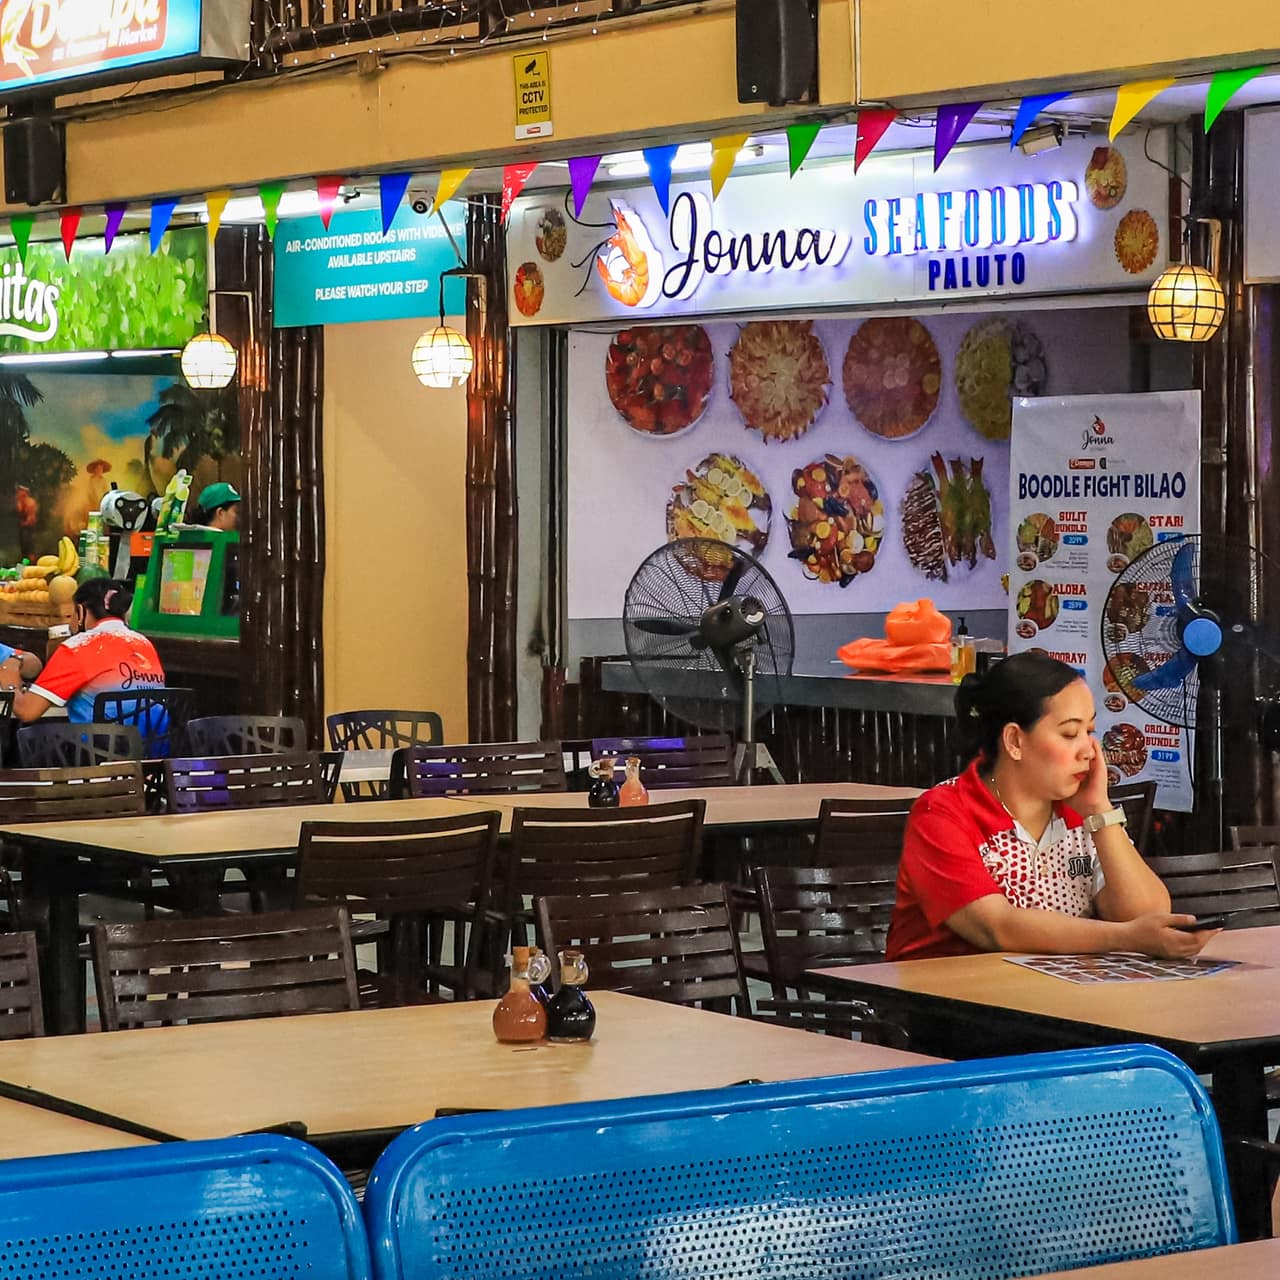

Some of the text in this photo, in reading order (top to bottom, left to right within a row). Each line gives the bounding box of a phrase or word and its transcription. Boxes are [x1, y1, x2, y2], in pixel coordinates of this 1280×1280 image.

[118, 25, 159, 47] Market
[522, 90, 544, 105] CCTV
[863, 181, 1064, 255] SEAFOODS
[285, 234, 362, 253] AIR-CONDITIONED
[363, 230, 396, 245] ROOMS
[397, 226, 421, 241] WITH
[661, 191, 837, 299] Jonna
[328, 248, 416, 269] AVAILABLE UPSTAIRS
[928, 252, 1027, 292] PALUTO
[315, 279, 428, 301] PLEASE WATCH YOUR STEP
[1081, 430, 1115, 450] Jonna
[1019, 472, 1186, 500] BOODLE FIGHT BILAO
[1059, 511, 1087, 522] SULIT
[1149, 515, 1184, 528] STAR!
[1051, 583, 1087, 597] ALOHA
[1145, 737, 1181, 748] BUNDLE
